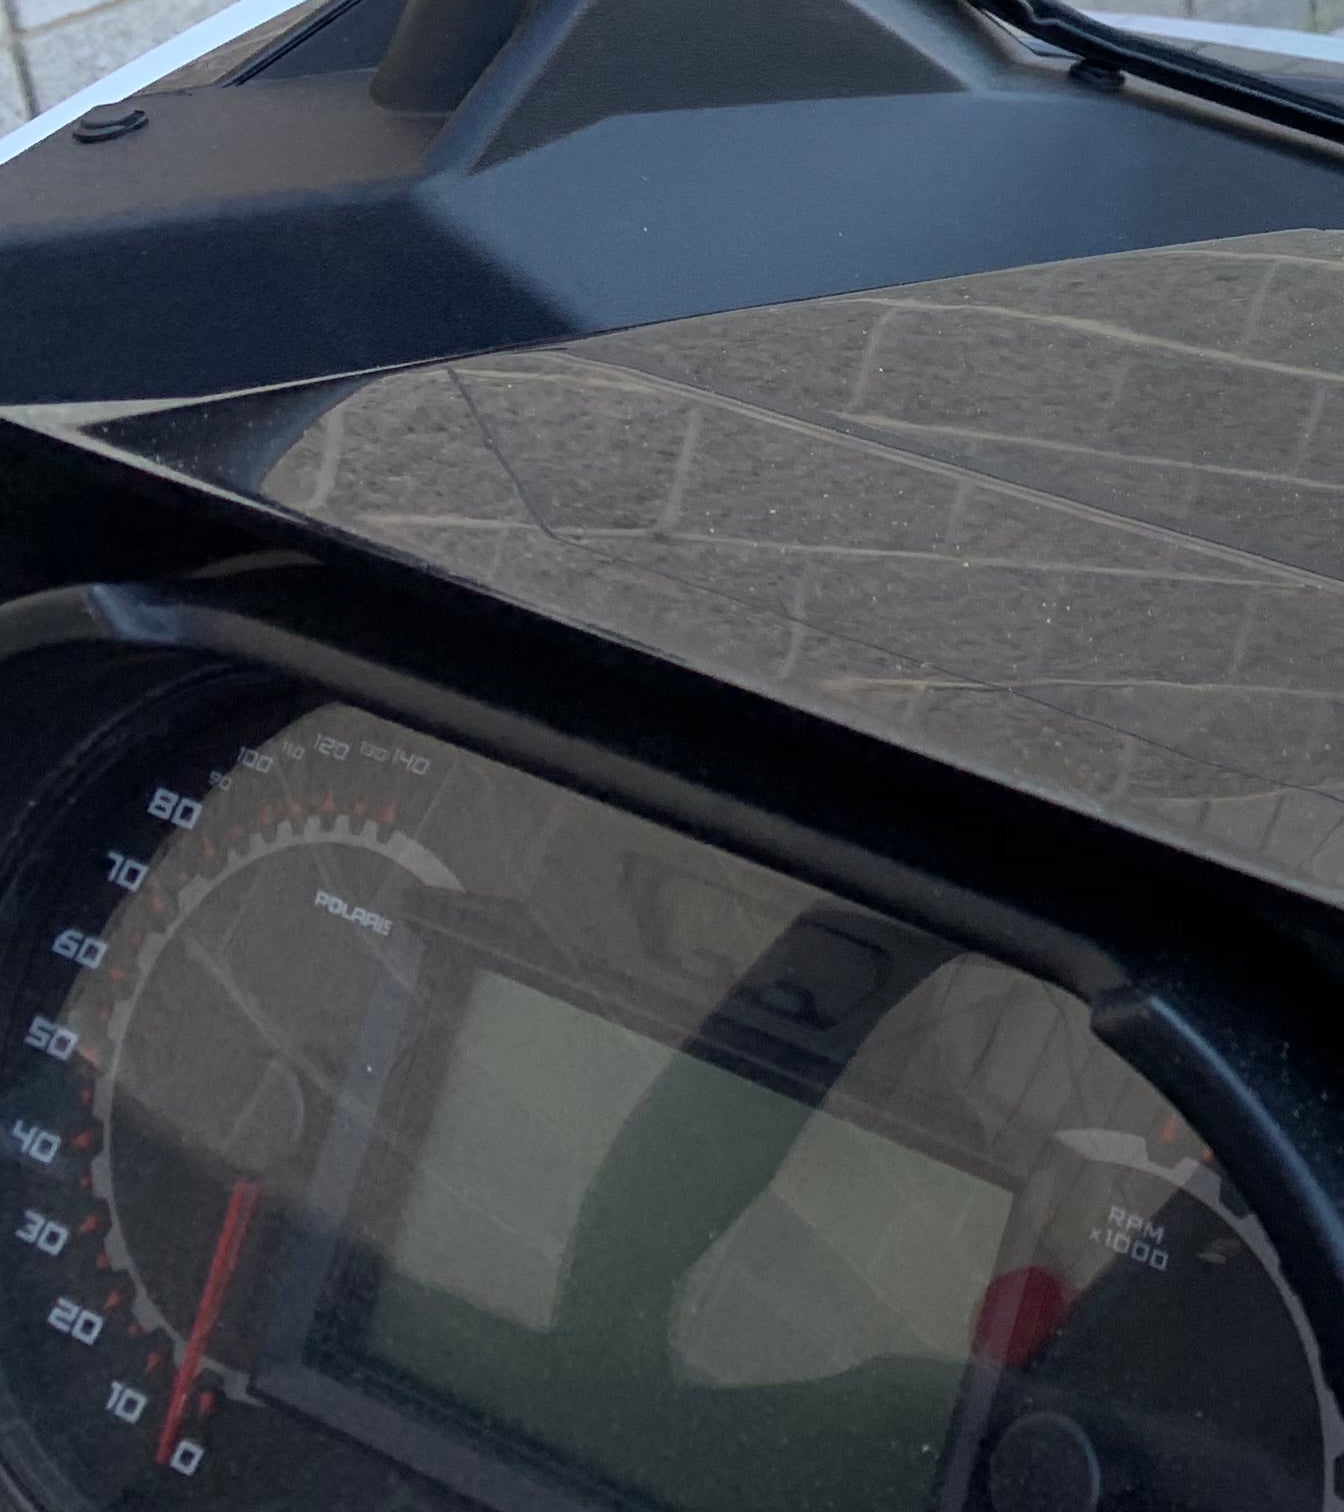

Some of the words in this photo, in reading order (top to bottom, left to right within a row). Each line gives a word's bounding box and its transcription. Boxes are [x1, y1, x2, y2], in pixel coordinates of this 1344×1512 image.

[237, 746, 274, 774] 100
[314, 734, 350, 760] 120
[392, 747, 431, 775] 140
[208, 771, 232, 790] 90
[147, 788, 202, 830] 80
[106, 850, 149, 892] 70
[314, 890, 393, 936] POLARIS
[51, 929, 107, 969] 60
[24, 1015, 78, 1060] 50
[12, 1119, 62, 1164] 40
[15, 1208, 69, 1256] 30
[1109, 1206, 1164, 1245] RPM
[48, 1296, 103, 1345] 20
[105, 1380, 147, 1424] 10
[170, 1440, 205, 1476] 0
